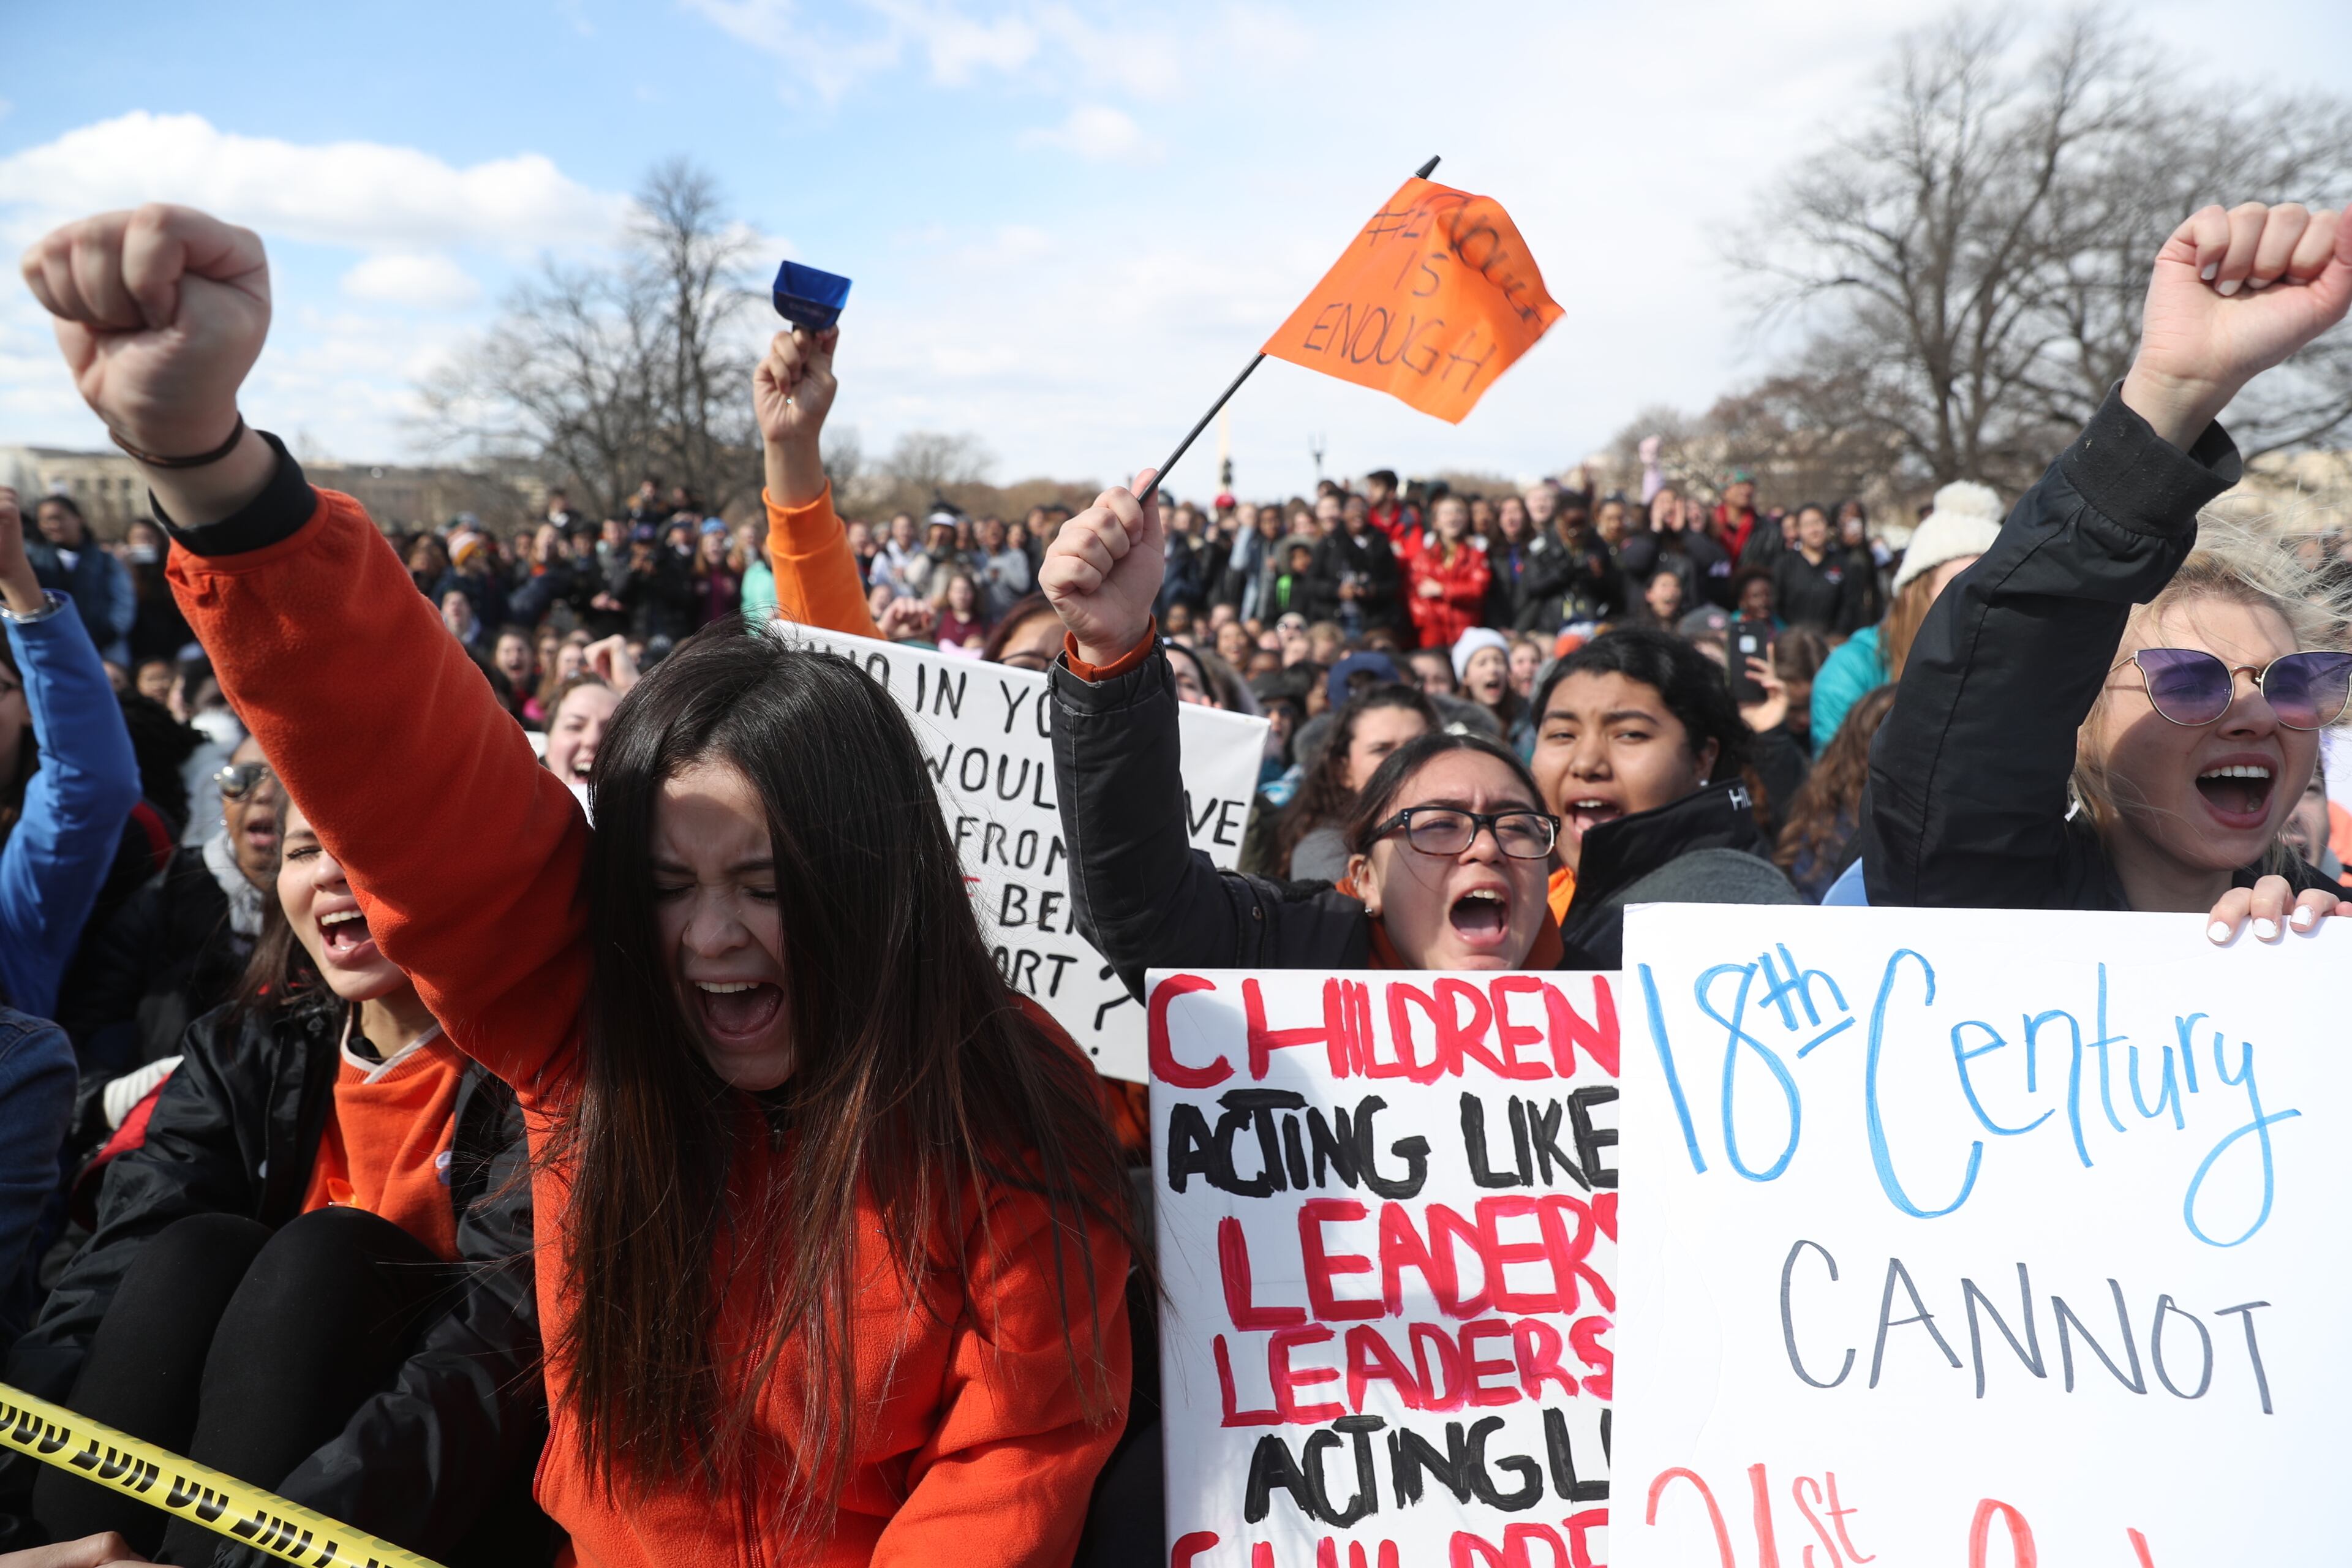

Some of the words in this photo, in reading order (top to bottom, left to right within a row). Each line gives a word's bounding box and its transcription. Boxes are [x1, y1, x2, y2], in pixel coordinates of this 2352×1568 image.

[1393, 250, 1449, 297] IS
[1303, 303, 1497, 393] ENOUGH
[915, 663, 967, 719] IN
[927, 744, 1056, 810] WOUL
[1183, 790, 1246, 846] VE
[1149, 973, 1620, 1088] CHILDREN
[1167, 1088, 1431, 1199] ACTING
[1460, 1087, 1618, 1191] LIKE
[1638, 943, 1855, 1183] 18th
[1866, 948, 2302, 1248] Century
[1213, 1316, 1614, 1428] LEADERS
[1780, 1240, 2273, 1415] CANNOT
[1244, 1415, 1544, 1529] ACTING
